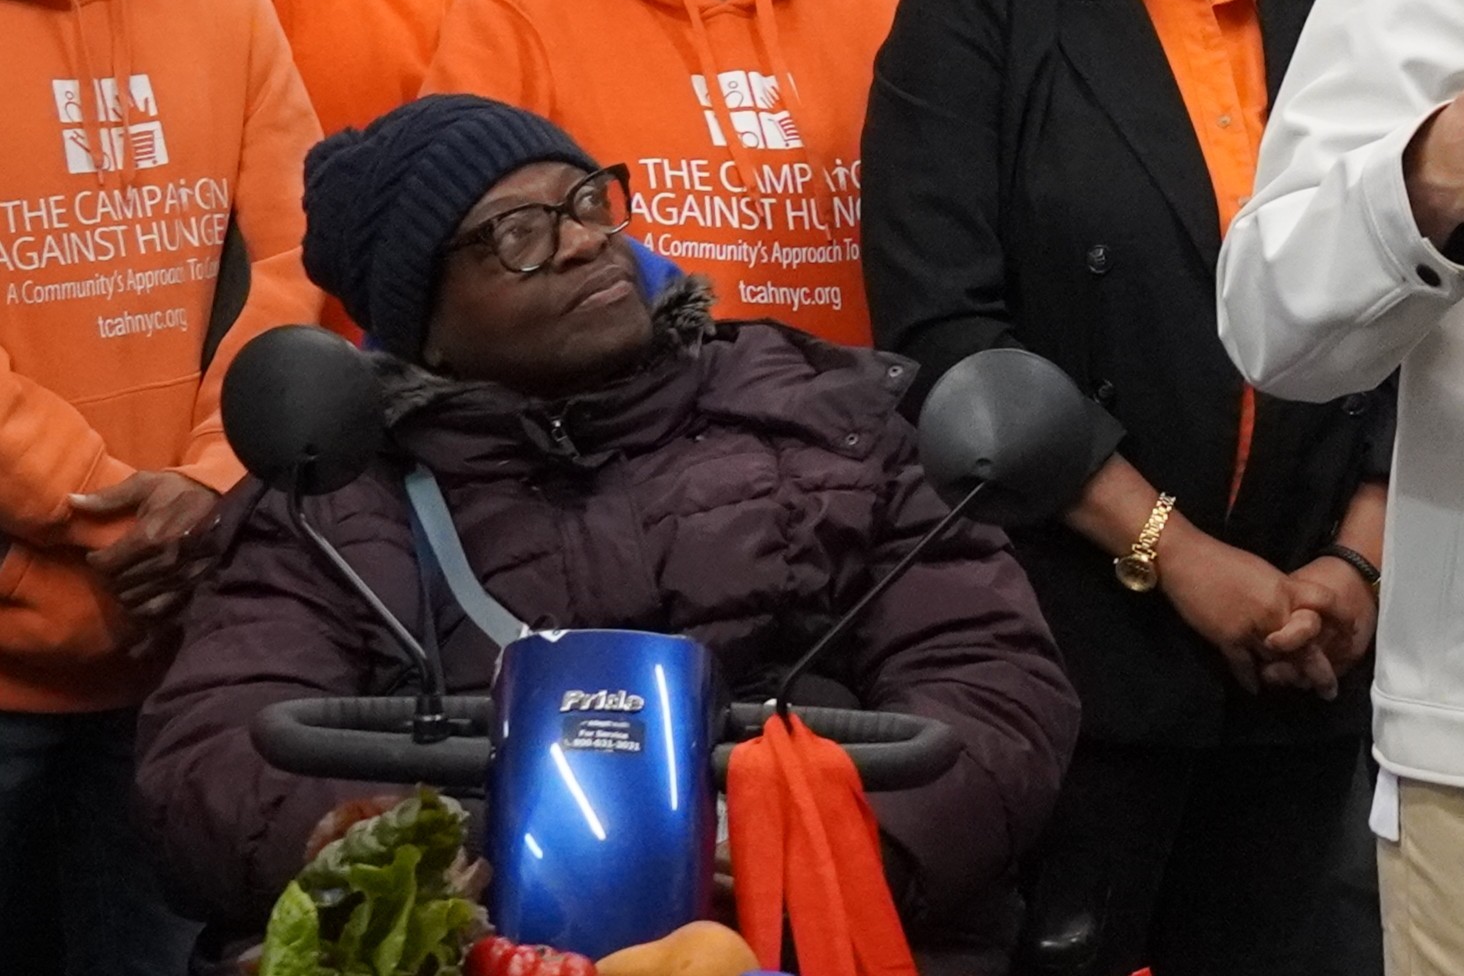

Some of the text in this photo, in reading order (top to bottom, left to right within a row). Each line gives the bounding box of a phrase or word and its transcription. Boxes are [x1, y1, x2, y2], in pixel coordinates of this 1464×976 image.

[638, 158, 713, 192] THE
[0, 195, 68, 233] THE
[630, 192, 777, 231] AGAINST
[135, 212, 230, 254] HUNGE
[642, 233, 859, 268] A Community's Approach To
[6, 282, 19, 305] A
[21, 269, 125, 305] Community's
[738, 281, 843, 312] tcahnyc.org
[97, 307, 188, 339] tcahnyc.org
[559, 690, 645, 713] Pride
